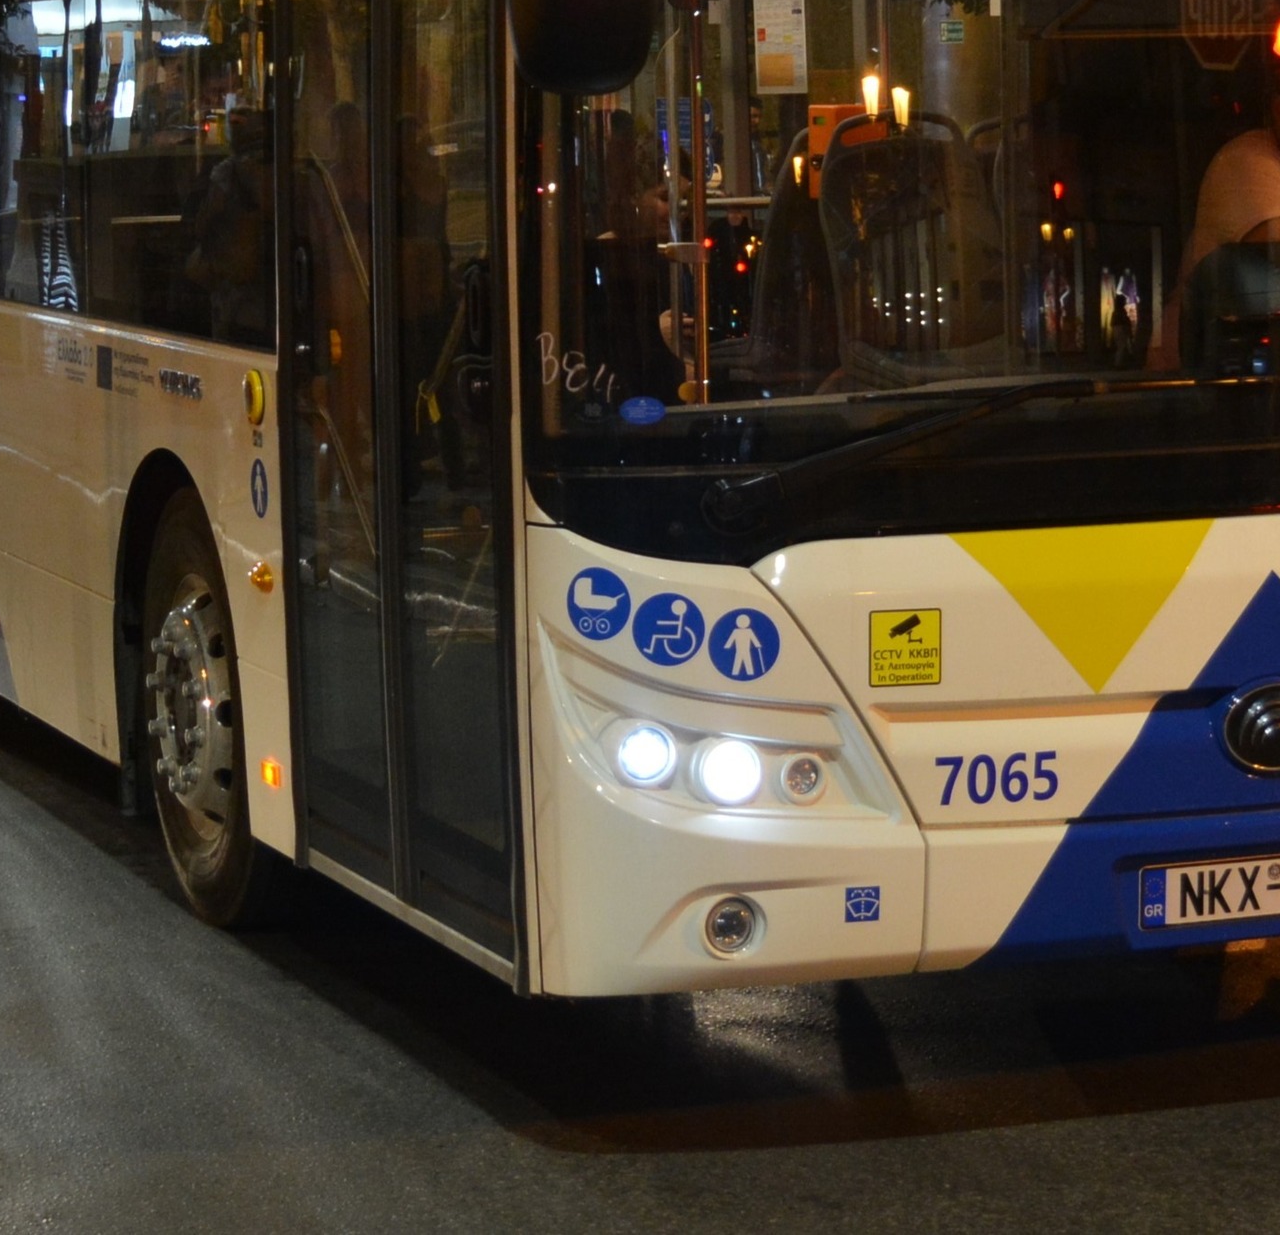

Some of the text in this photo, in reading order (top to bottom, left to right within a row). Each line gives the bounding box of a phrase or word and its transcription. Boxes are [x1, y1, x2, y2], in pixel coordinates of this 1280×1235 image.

[873, 647, 938, 661] CCTV ΚΚΒΠ
[888, 660, 935, 672] Λειτουργία
[878, 672, 934, 683] In Operation
[935, 750, 1059, 806] 7065
[1144, 903, 1163, 918] GR
